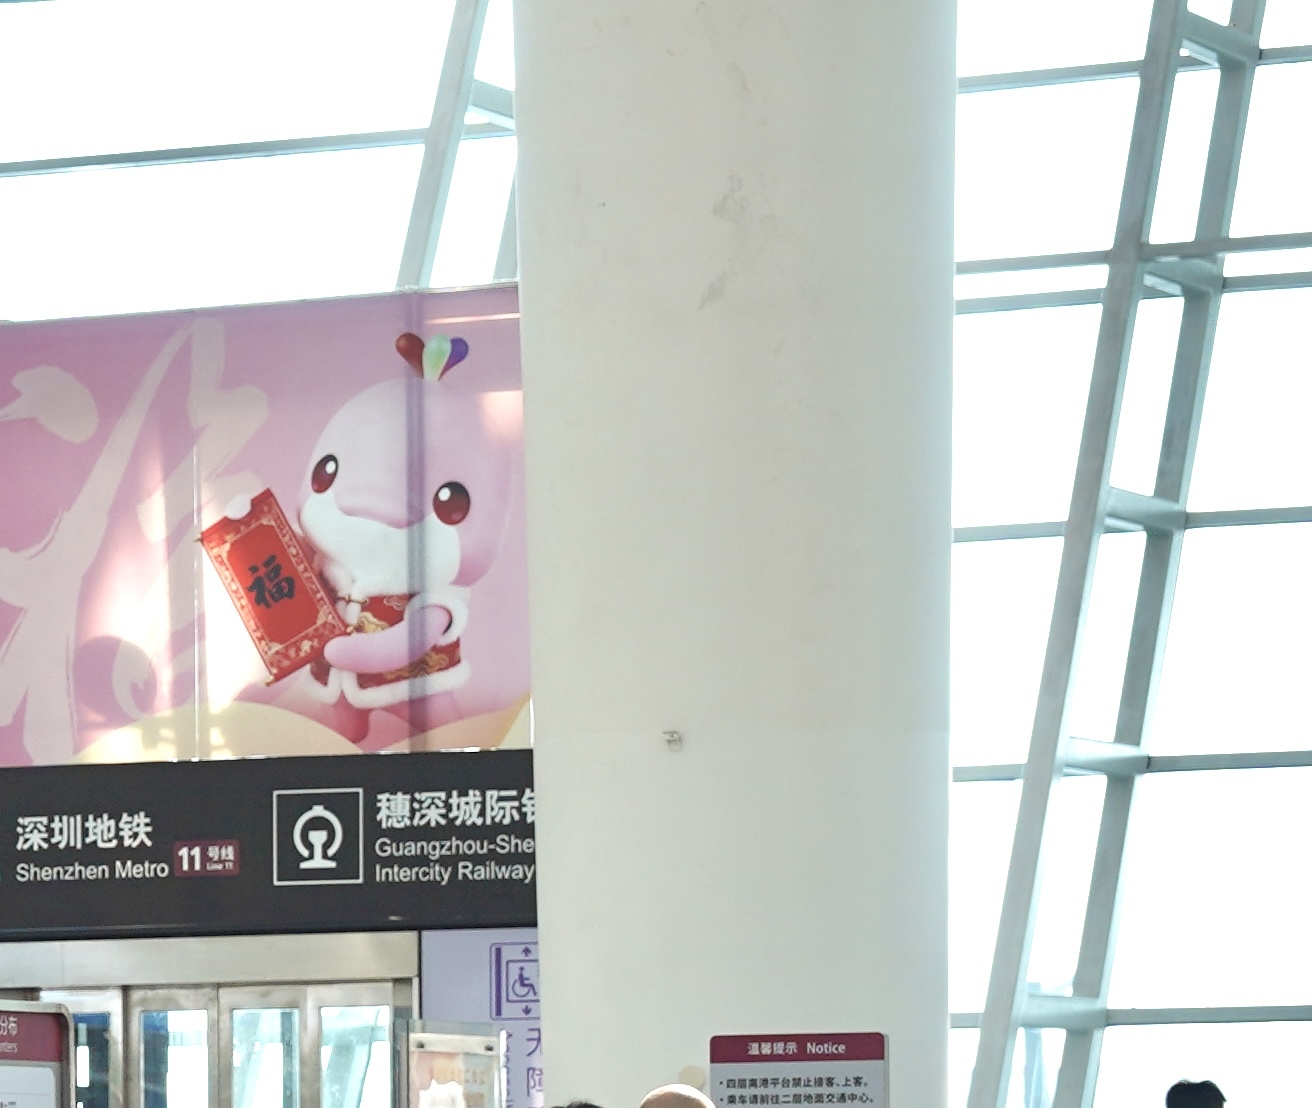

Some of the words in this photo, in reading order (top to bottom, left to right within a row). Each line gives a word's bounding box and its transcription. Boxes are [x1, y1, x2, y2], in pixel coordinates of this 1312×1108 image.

[246, 553, 297, 611] 福
[15, 810, 154, 852] 深圳地铁
[177, 845, 202, 872] 11
[206, 845, 235, 862] 号线
[375, 834, 535, 860] Guangzhou-She
[15, 862, 110, 883] Shenzhen
[114, 859, 170, 880] Metro
[376, 861, 452, 885] Intercity
[458, 860, 535, 885] Railway
[747, 1042, 798, 1055] 温馨提示
[806, 1041, 847, 1054] Notice
[727, 1092, 875, 1105] 乘车请前往二层地面交通中心。
